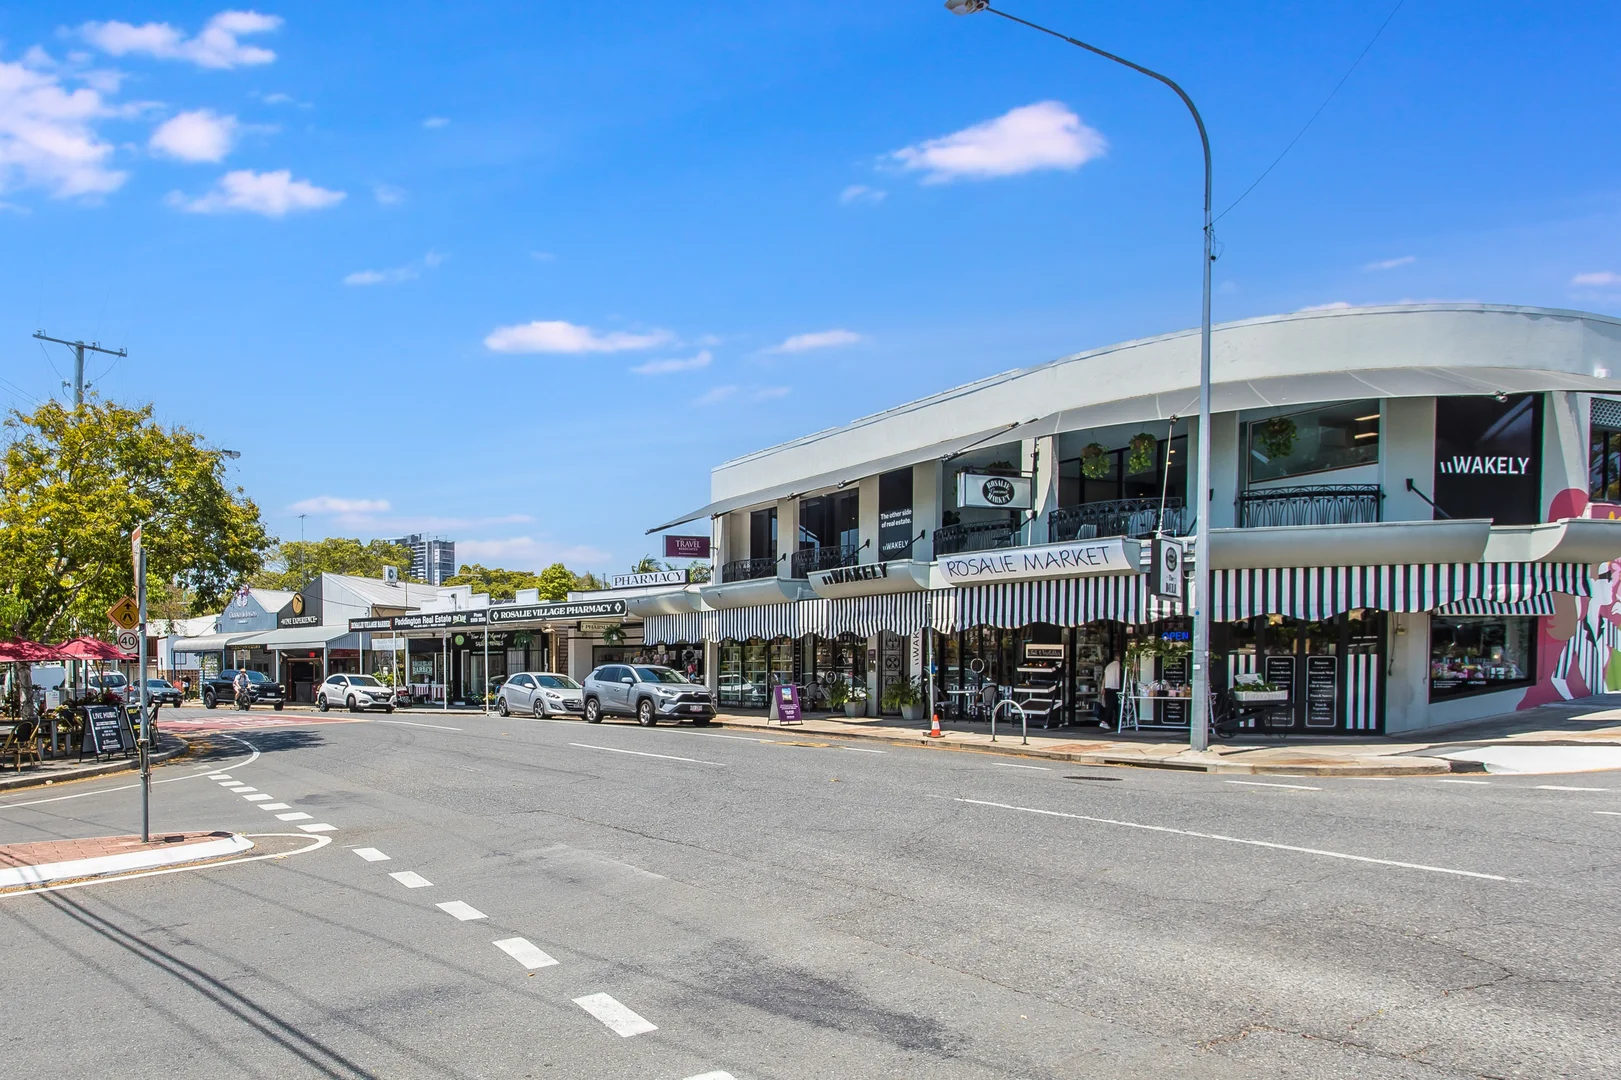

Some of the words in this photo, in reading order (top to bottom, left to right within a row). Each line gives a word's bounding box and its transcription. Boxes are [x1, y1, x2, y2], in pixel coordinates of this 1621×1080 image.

[1453, 455, 1530, 475] WAKELY
[986, 480, 1010, 490] ROSALIE
[987, 493, 1011, 504] MARKET
[901, 508, 912, 516] side
[881, 521, 887, 529] of
[886, 519, 896, 527] real
[895, 517, 912, 526] estate.
[675, 540, 701, 549] TRAVEL
[886, 540, 909, 550] WAKELY
[946, 555, 1017, 578] ROSALIE
[1023, 545, 1109, 572] MARKET
[614, 571, 684, 587] PHARMACY
[829, 562, 888, 585] WAKELY
[1165, 582, 1177, 594] DELI
[501, 610, 532, 619] ROSALIE
[532, 607, 565, 617] VILLAGE
[566, 604, 612, 615] PHARMACY
[422, 615, 434, 624] Real
[434, 614, 452, 623] Estate
[121, 636, 135, 646] 40
[1162, 631, 1189, 641] OPEN
